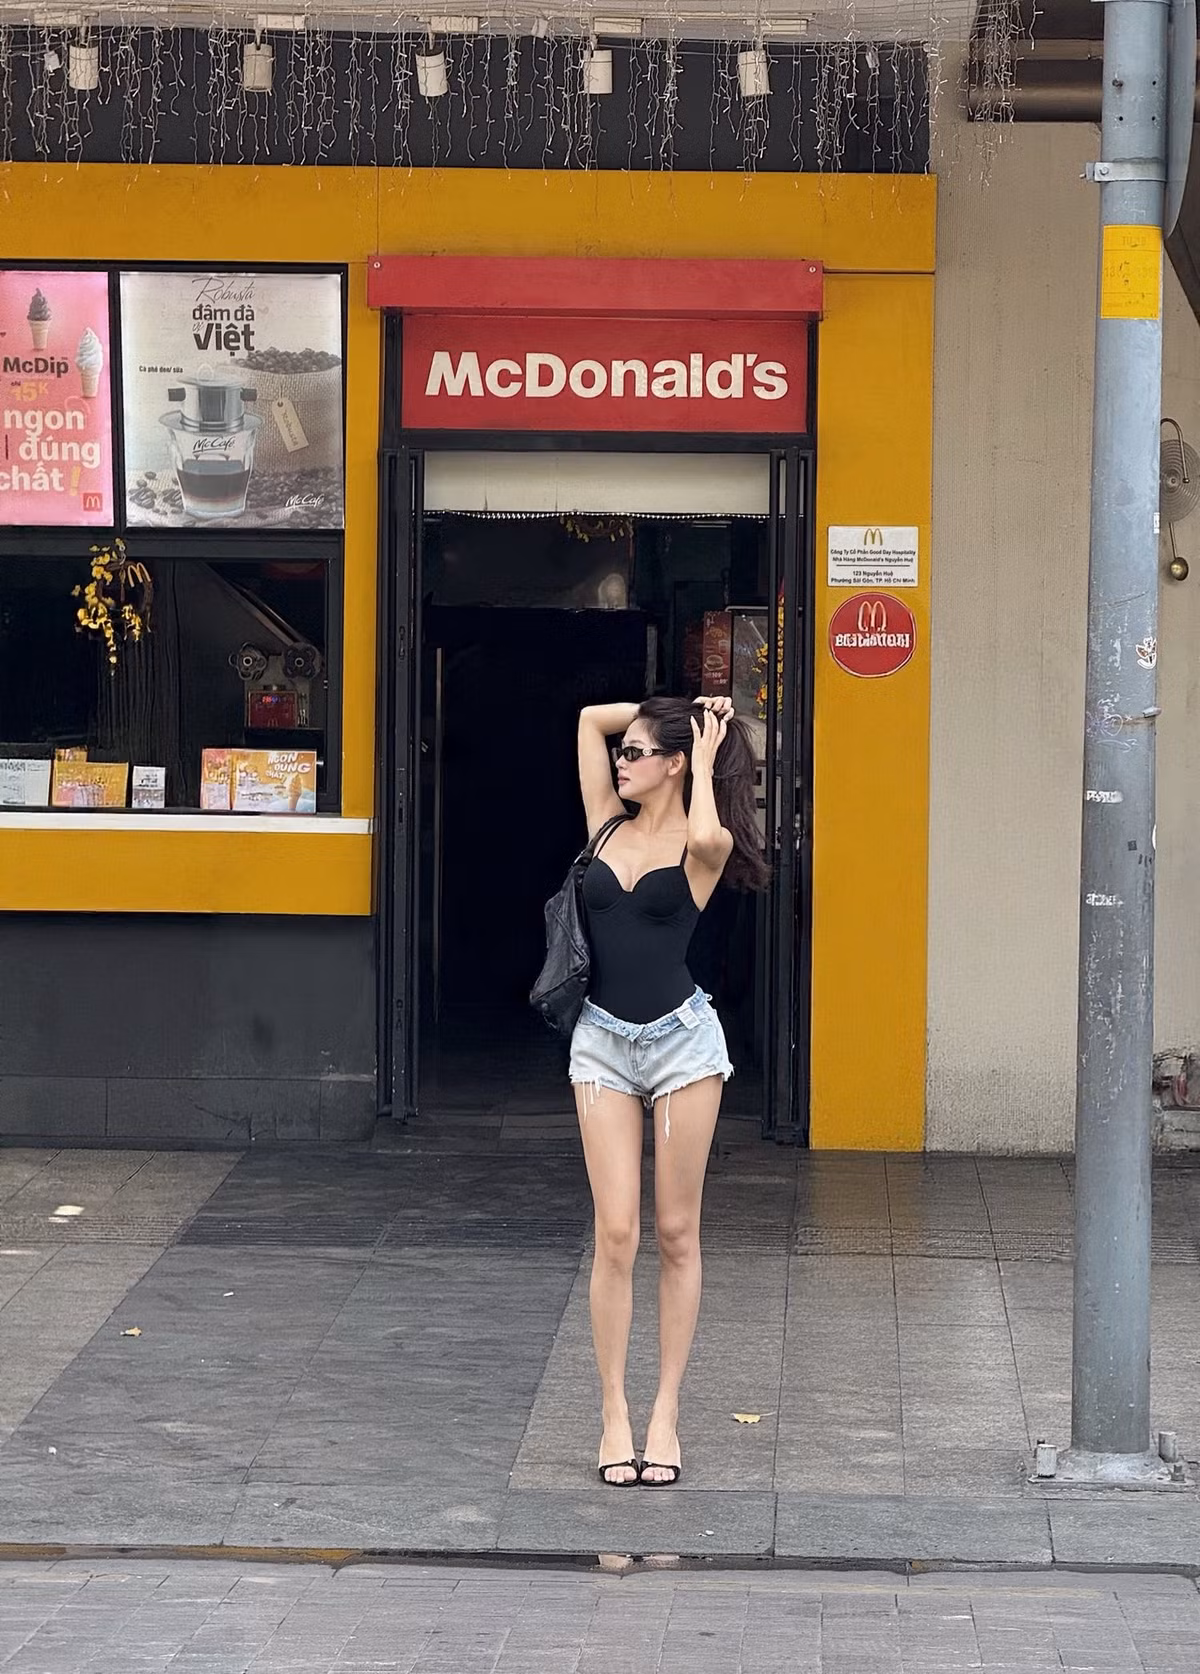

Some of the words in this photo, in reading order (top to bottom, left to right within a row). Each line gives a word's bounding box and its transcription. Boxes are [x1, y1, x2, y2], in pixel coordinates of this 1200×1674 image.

[192, 277, 255, 304] Robusta
[234, 304, 255, 322] đà
[193, 322, 255, 357] Việt
[424, 350, 789, 400] McDonald's
[4, 409, 84, 436] ngon
[19, 435, 100, 469] đúng
